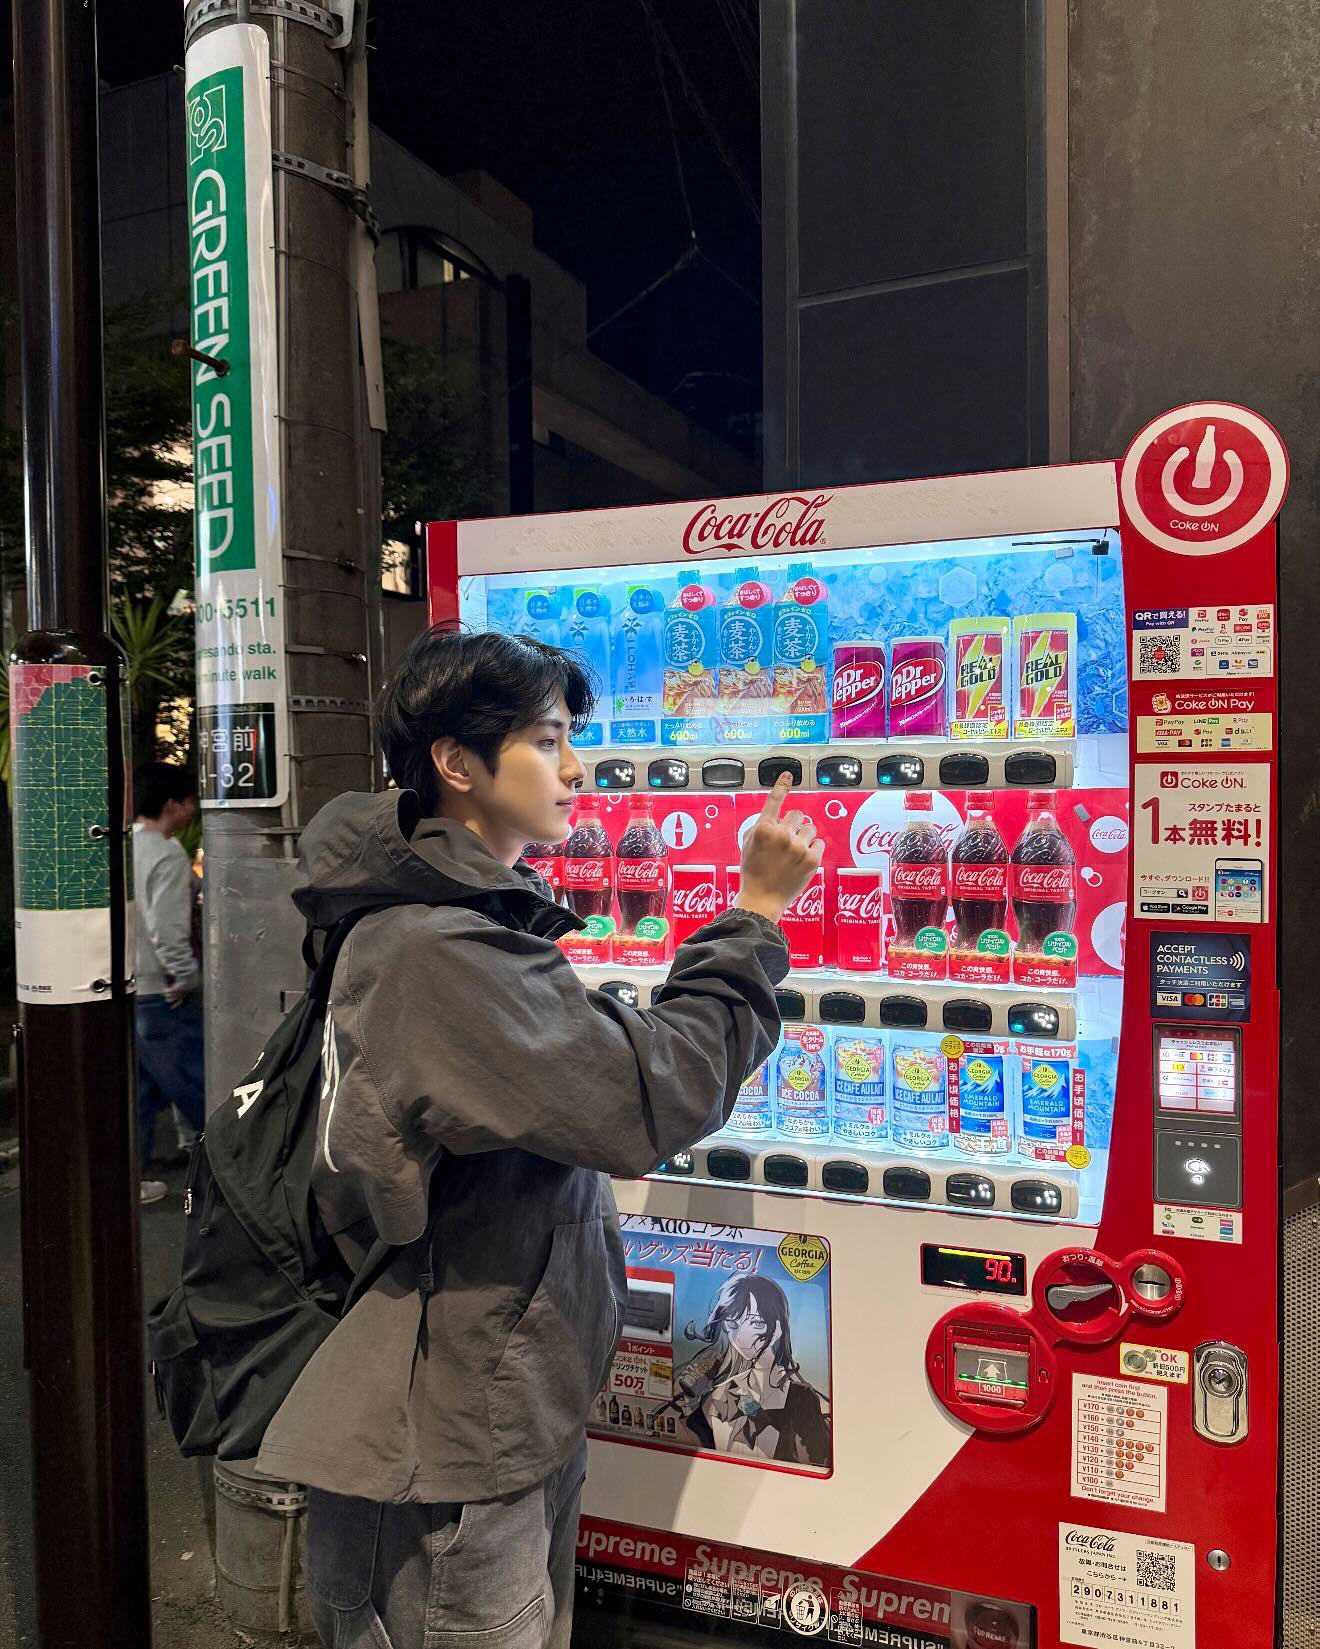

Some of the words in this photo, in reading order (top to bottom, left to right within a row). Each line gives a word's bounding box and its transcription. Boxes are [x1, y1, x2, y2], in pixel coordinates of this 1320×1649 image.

[191, 168, 229, 386] GREEN
[196, 393, 234, 560] SEED
[683, 493, 835, 554] Coca-Cola
[1170, 520, 1199, 531] Coke
[1136, 610, 1186, 620] QRで買える!
[672, 624, 690, 662] 麦茶
[729, 620, 748, 660] 麦茶
[784, 618, 802, 658] 麦茶
[248, 642, 276, 655] sta.
[961, 656, 994, 676] REAL
[1026, 652, 1062, 674] REAL
[242, 666, 276, 681] walk
[842, 668, 864, 687] Dr
[901, 665, 924, 682] Dr
[960, 668, 997, 688] GOLD
[1026, 665, 1062, 686] GOLD
[834, 676, 876, 704] Pepper
[892, 672, 937, 702] Pepper
[1174, 700, 1206, 710] Coke
[1230, 699, 1255, 712] Pay
[617, 728, 648, 738] 天然水
[669, 731, 698, 741] 600ml
[723, 730, 753, 740] 600ml
[779, 728, 810, 738] 600ml
[1180, 778, 1218, 788] Coke
[1188, 803, 1262, 813] スタンプたまると
[618, 860, 660, 878] Coca-Cola
[894, 867, 942, 887] Coca-Cola
[956, 868, 1004, 888] Coca-Cola
[1020, 868, 1070, 888] Coca-Cola
[1157, 944, 1196, 954] ACCEPT
[1156, 954, 1228, 965] CONTACTLESS
[894, 970, 939, 978] コカ・コーラだけ。
[1156, 964, 1208, 974] PAYMENTS
[954, 972, 1002, 982] コカ・コーラだけ。
[1020, 976, 1068, 985] コカ・コーラだけ。
[1019, 1044, 1072, 1058] お手軽な170g
[740, 1086, 764, 1096] COCOA
[782, 1088, 793, 1100] ICE
[794, 1090, 820, 1100] COCOA
[844, 1082, 860, 1092] CAFE
[860, 1083, 869, 1095] AU
[870, 1084, 884, 1096] LAIT
[948, 1061, 960, 1129] お手頃価格!
[233, 1080, 264, 1119] A
[903, 1090, 920, 1102] CAFE
[921, 1092, 931, 1104] AU
[930, 1092, 944, 1104] LAIT
[1074, 1072, 1085, 1142] お手頃価格!
[903, 1138, 936, 1146] やさしいコク
[781, 1246, 825, 1260] GEORGIA
[626, 1342, 656, 1354] 1ポイント
[1160, 1353, 1178, 1364] OK
[614, 1373, 646, 1390] 50万
[1096, 1378, 1114, 1388] Insert
[982, 1384, 1002, 1393] 1000
[1094, 1384, 1108, 1392] then
[1126, 1388, 1136, 1396] the
[1083, 1402, 1100, 1410] ¥170
[1083, 1414, 1099, 1422] ¥160
[1082, 1424, 1098, 1432] ¥150
[1082, 1434, 1098, 1442] ¥140
[1082, 1445, 1098, 1453] ¥130
[1082, 1456, 1098, 1464] ¥120
[1082, 1466, 1098, 1474] ¥110
[1082, 1476, 1098, 1484] ¥100
[1065, 1530, 1118, 1552] Coca-Cola
[1086, 1571, 1116, 1581] こちらから
